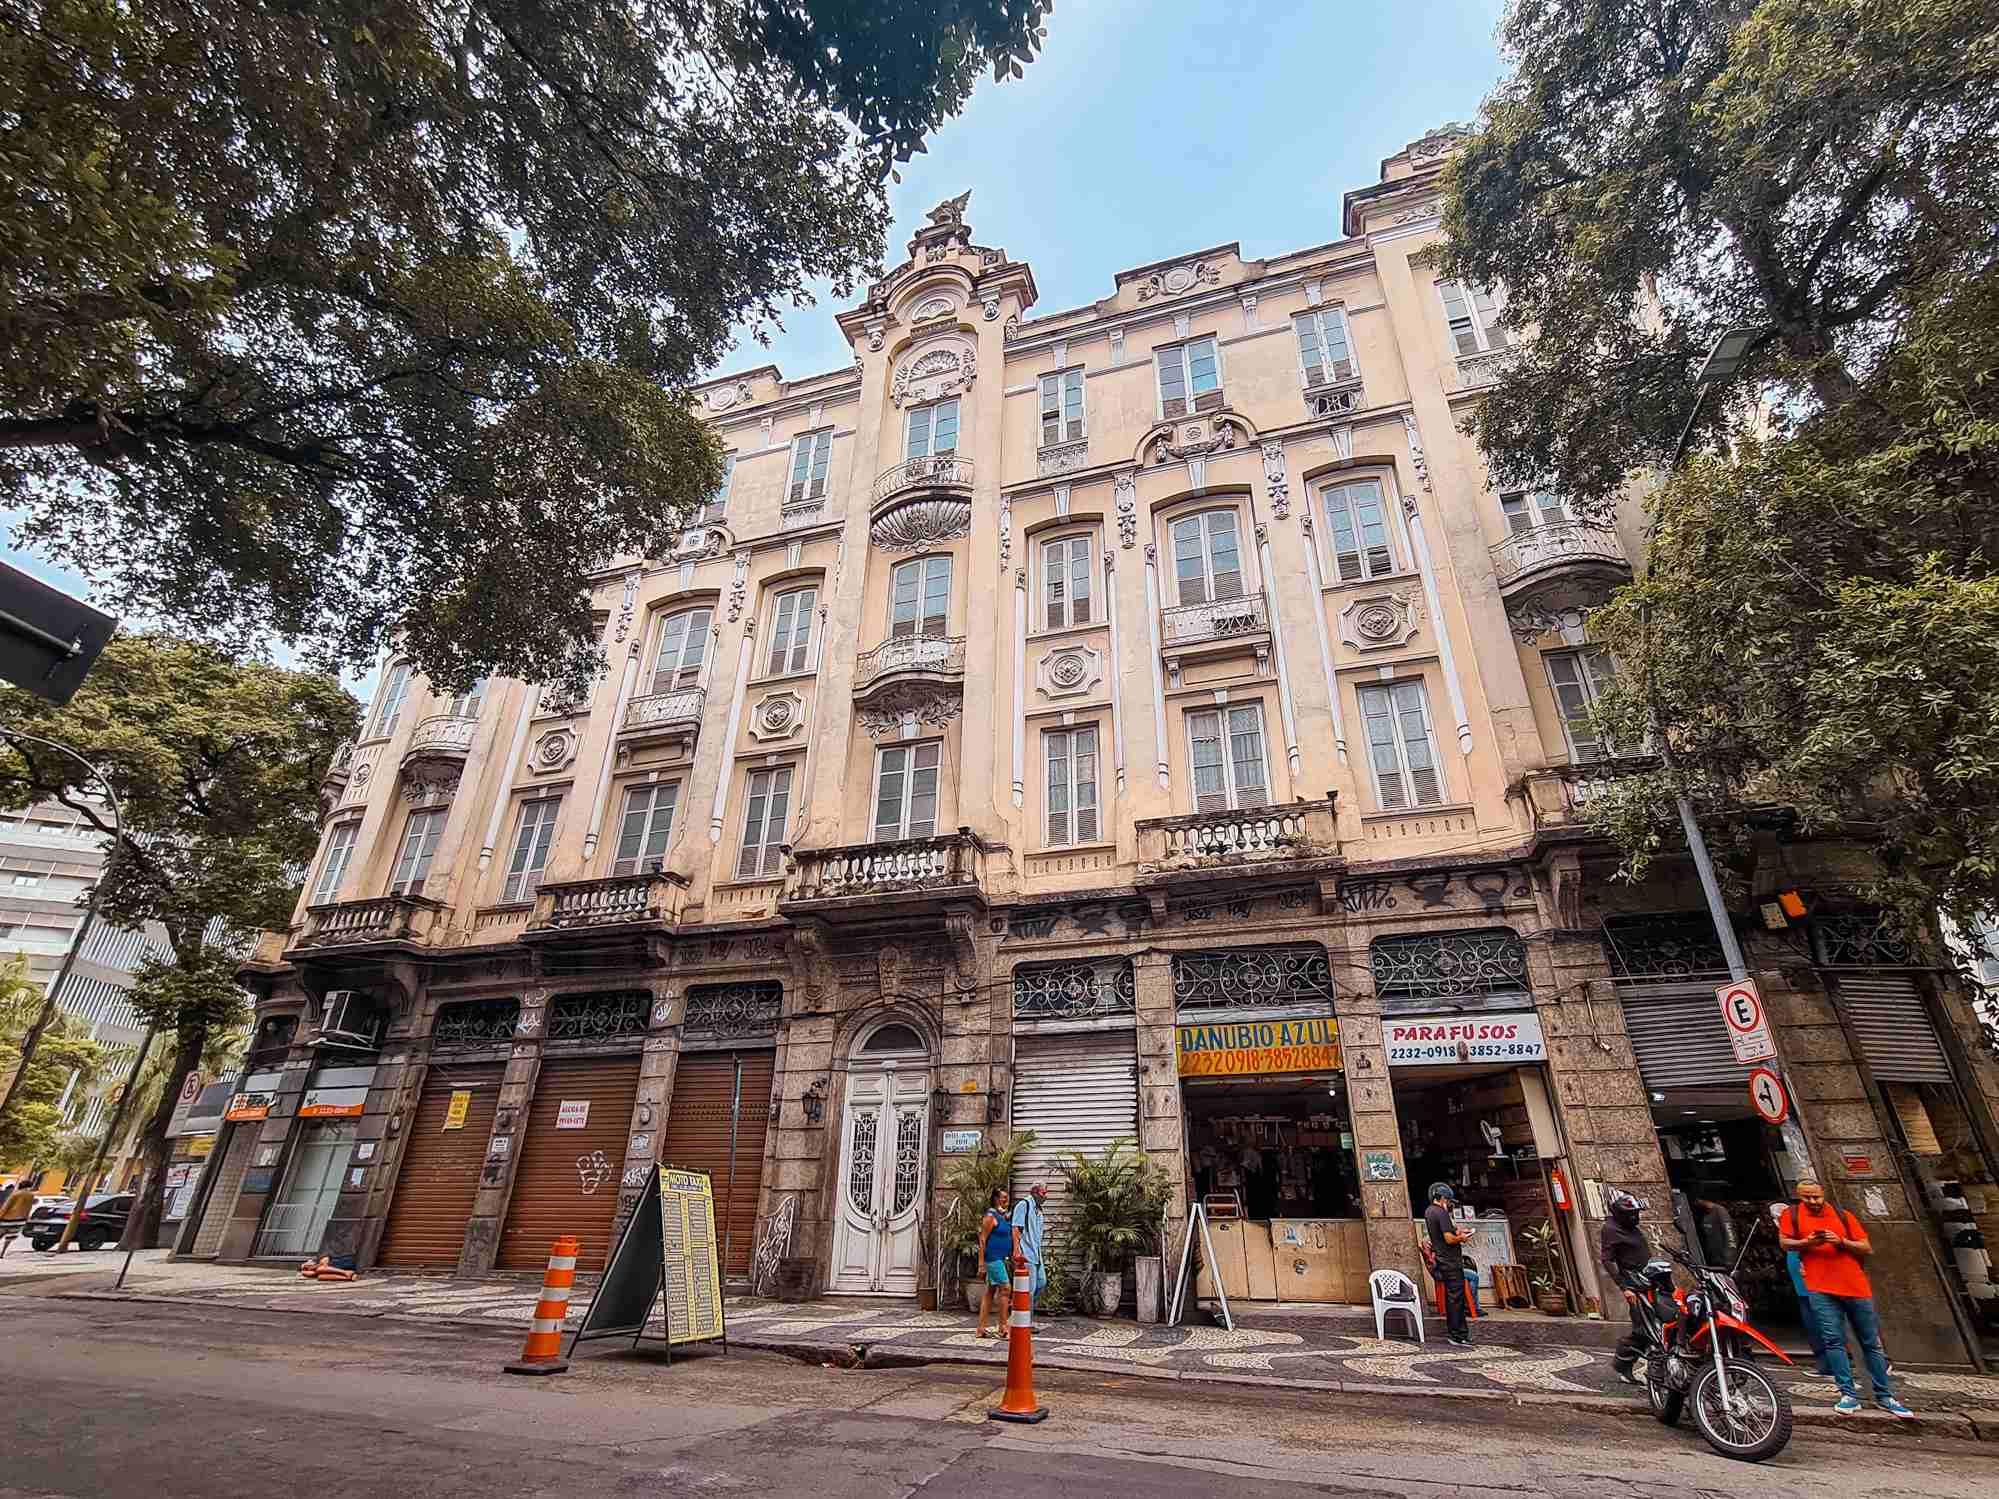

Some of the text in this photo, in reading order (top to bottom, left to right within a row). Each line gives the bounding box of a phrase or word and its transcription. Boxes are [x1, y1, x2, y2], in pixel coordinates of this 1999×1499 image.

[1733, 999, 1751, 1023] E
[1181, 1020, 1338, 1051] DANUBIO AZUL
[1391, 1044, 1541, 1059] 2232-0918 3852-8847
[670, 1172, 688, 1185] MOTO
